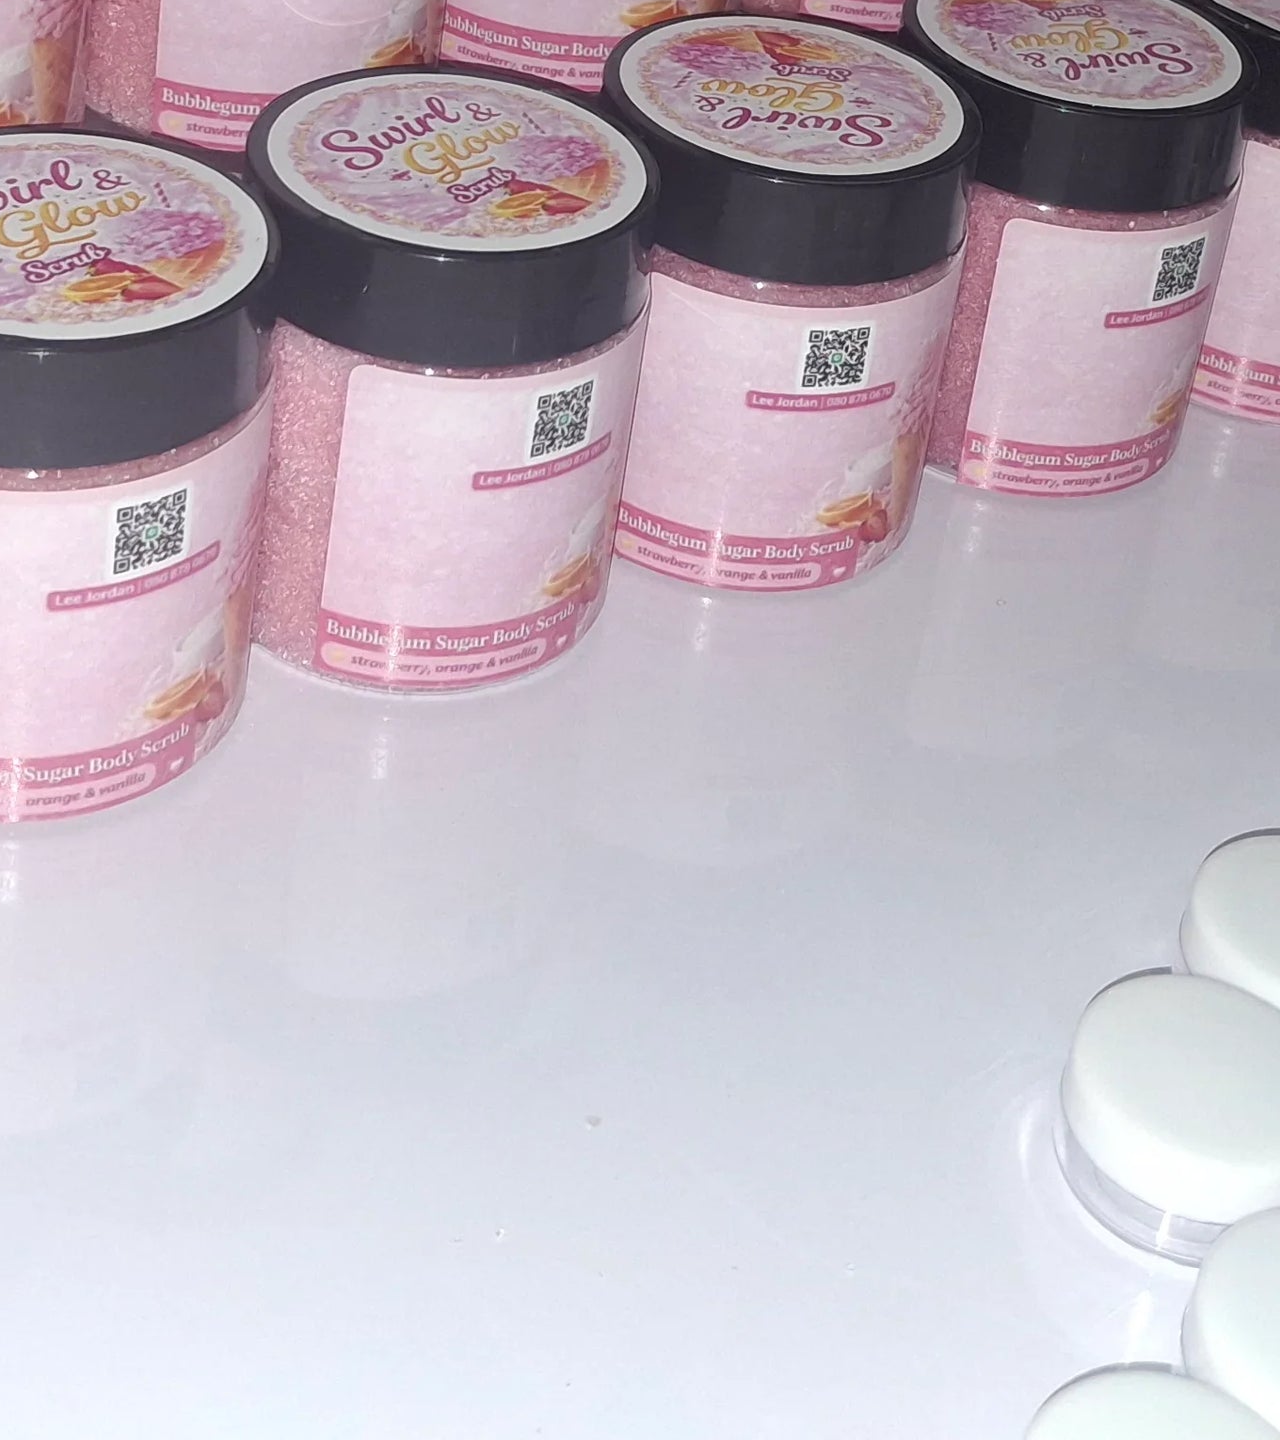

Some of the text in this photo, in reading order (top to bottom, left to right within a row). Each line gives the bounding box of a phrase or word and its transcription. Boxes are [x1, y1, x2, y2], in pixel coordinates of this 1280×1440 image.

[1038, 4, 1107, 22] Scrub
[521, 34, 569, 57] Sugar
[572, 42, 612, 60] Body
[1009, 18, 1129, 54] Glow
[521, 62, 565, 78] orange
[566, 67, 576, 78] &
[769, 63, 852, 84] Scrub
[1016, 41, 1194, 82] Swirl &
[161, 86, 260, 117] Bubblegum
[699, 77, 845, 115] Glow
[320, 96, 502, 171] Swirl &
[694, 94, 893, 148] Swirl &
[403, 119, 521, 185] Glow
[93, 168, 133, 192] &
[445, 166, 517, 204] Scrub
[20, 242, 111, 284] Scrub
[1110, 310, 1163, 325] Lee Jordan
[752, 394, 773, 406] Lee
[775, 395, 818, 408] Jordan
[1063, 446, 1141, 468] Sugar Body
[479, 466, 546, 486] Lee Jordan
[1063, 476, 1101, 488] orange
[619, 508, 854, 560] Bubblegum Body Scrub
[637, 545, 706, 577] strawberry,
[771, 568, 812, 580] vanilla
[55, 584, 135, 607] Lee Jordan
[435, 603, 576, 653] Sugar Body Scrub
[435, 645, 539, 675] orange & vanilla
[23, 723, 190, 783] Sugar Body Scrub
[25, 771, 146, 807] orange & vanilla
